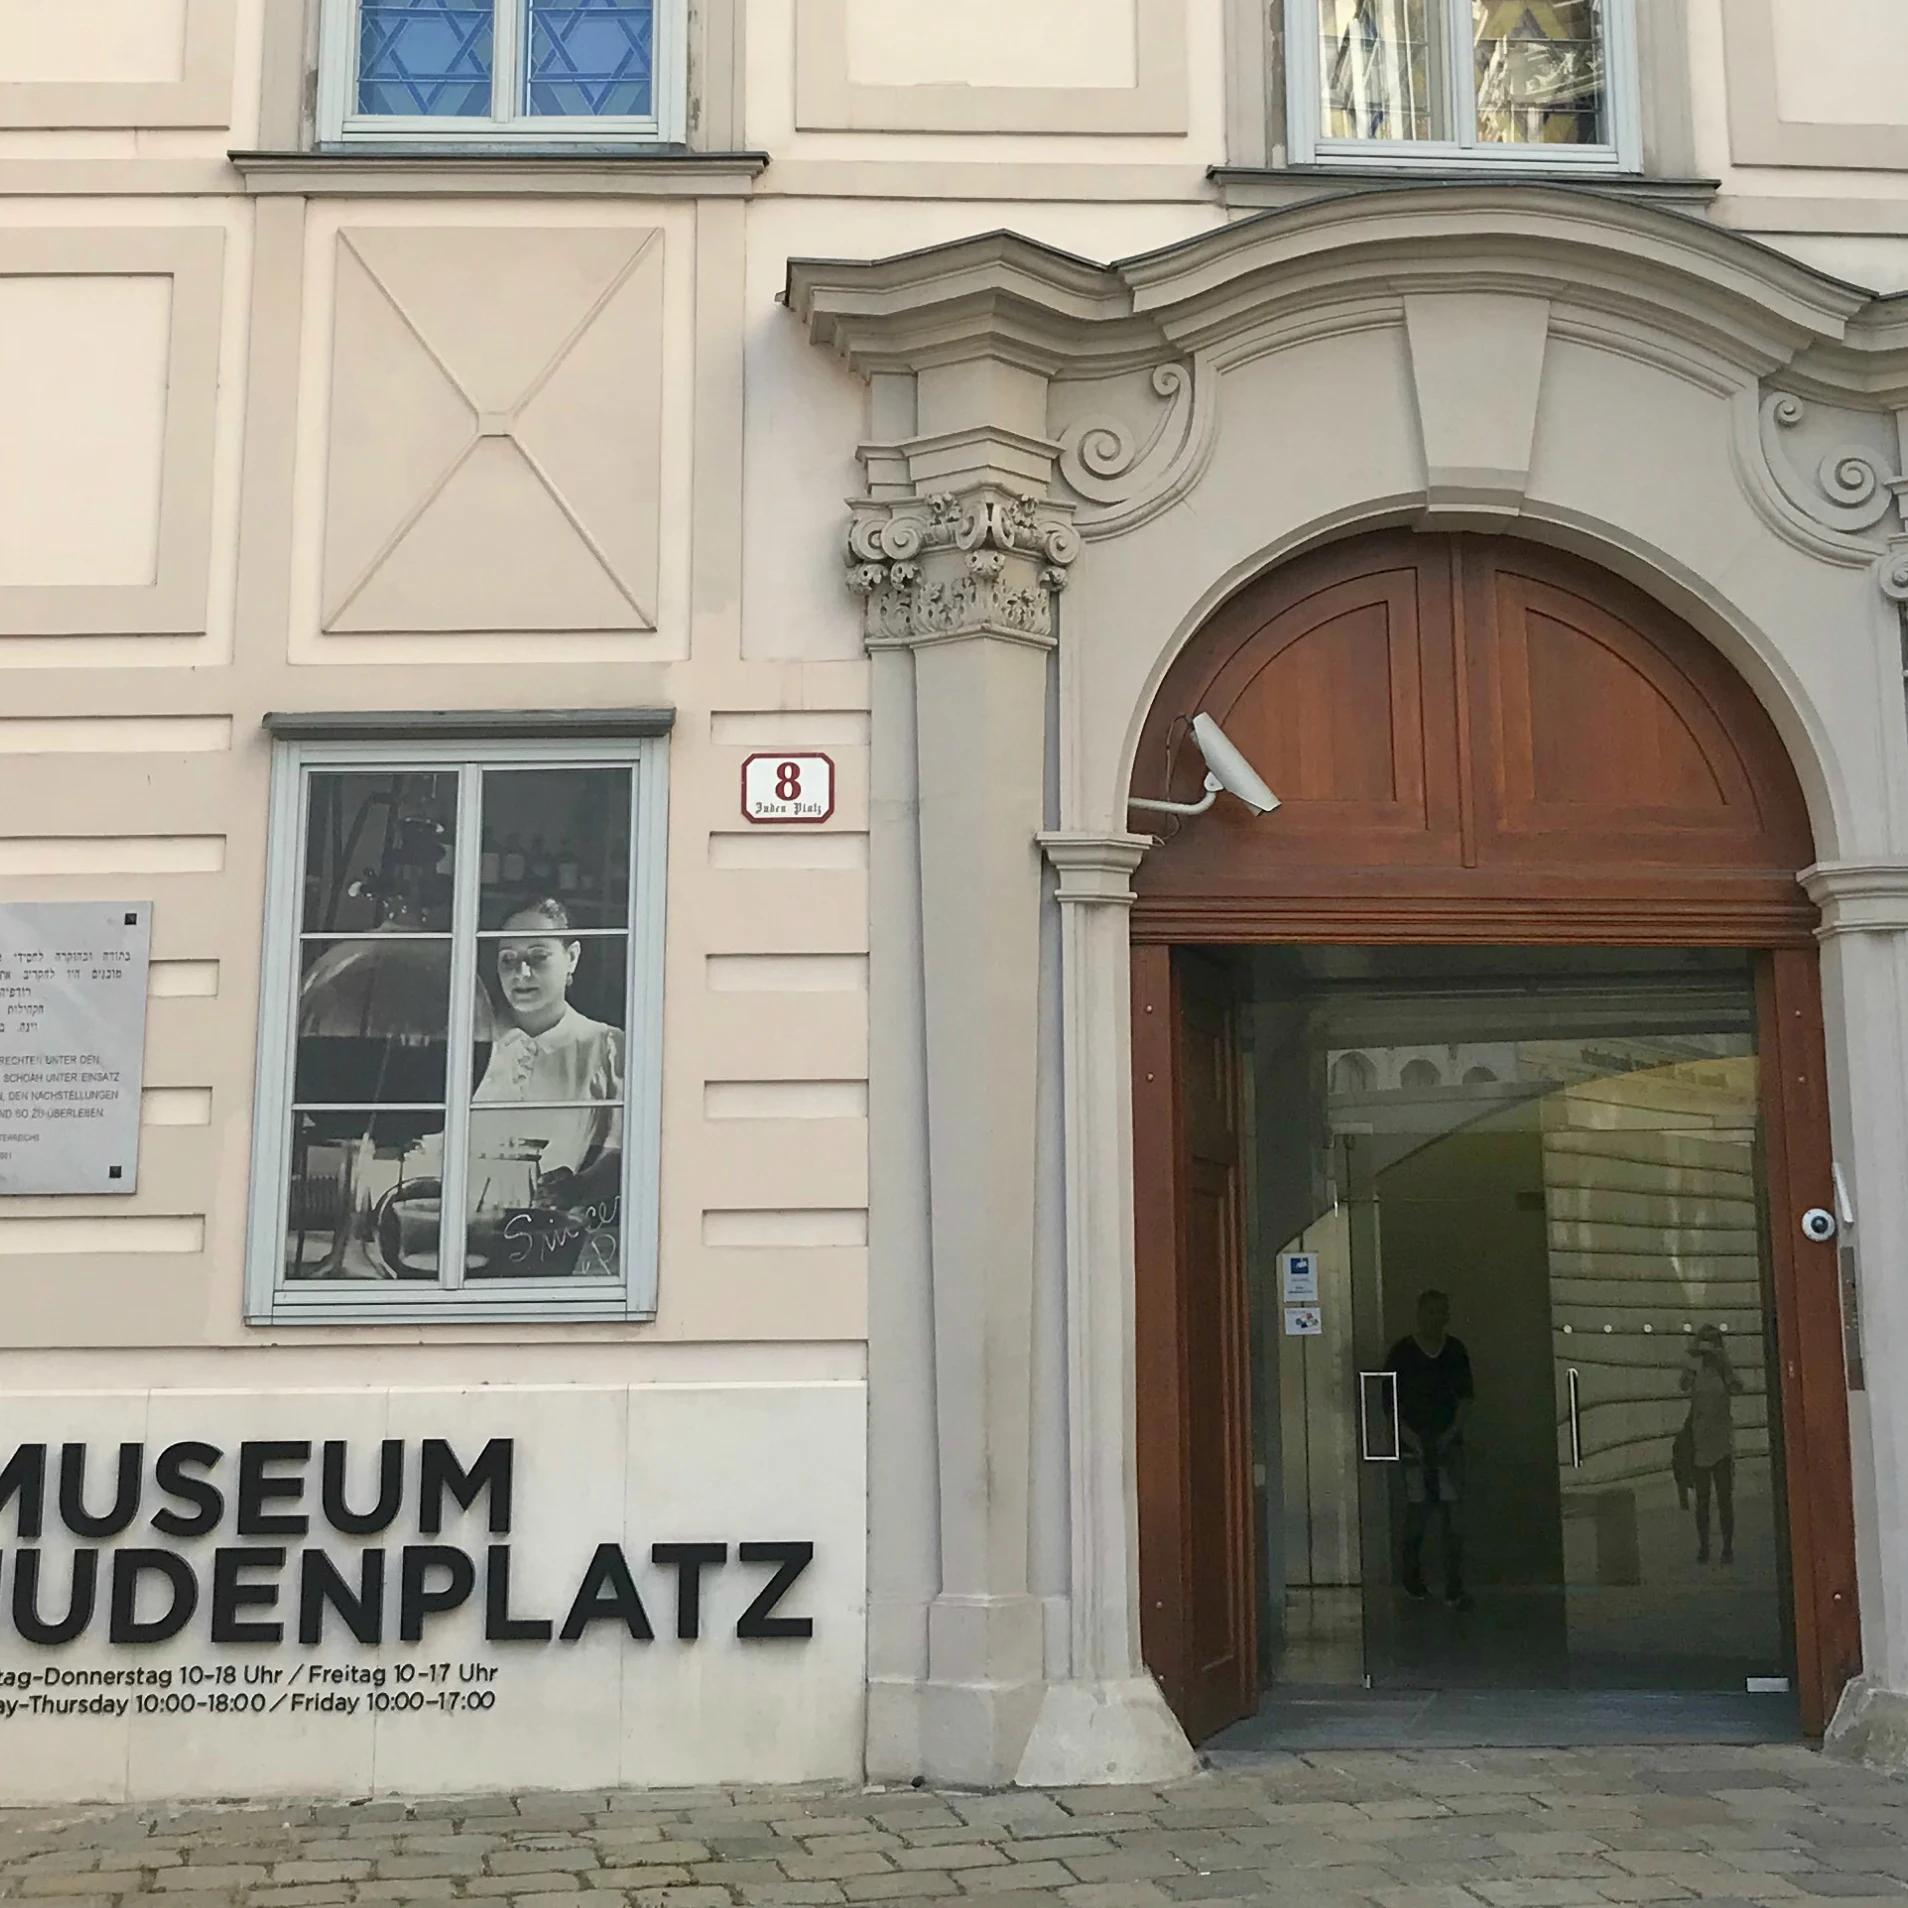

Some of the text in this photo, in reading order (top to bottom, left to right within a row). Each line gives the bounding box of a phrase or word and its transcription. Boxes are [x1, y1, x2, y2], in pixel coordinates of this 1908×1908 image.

[775, 762, 801, 801] 8
[755, 802, 822, 815] Juden Platz
[45, 1055, 77, 1065] UNTER
[80, 1055, 100, 1064] DEN
[3, 1071, 120, 1083] SCHOAH UNTER EINSATZ
[8, 1091, 28, 1101] DEN
[0, 1541, 813, 1644] UDENPLATZ
[180, 1665, 236, 1684] 10-18
[244, 1665, 283, 1684] Uhr
[308, 1664, 386, 1686] Freitag
[394, 1663, 451, 1682] 10-17
[459, 1663, 498, 1682] Uhr
[136, 1693, 266, 1712] 10:00-18:00
[291, 1692, 360, 1714] Friday
[367, 1691, 496, 1711] 10:00-17:00
